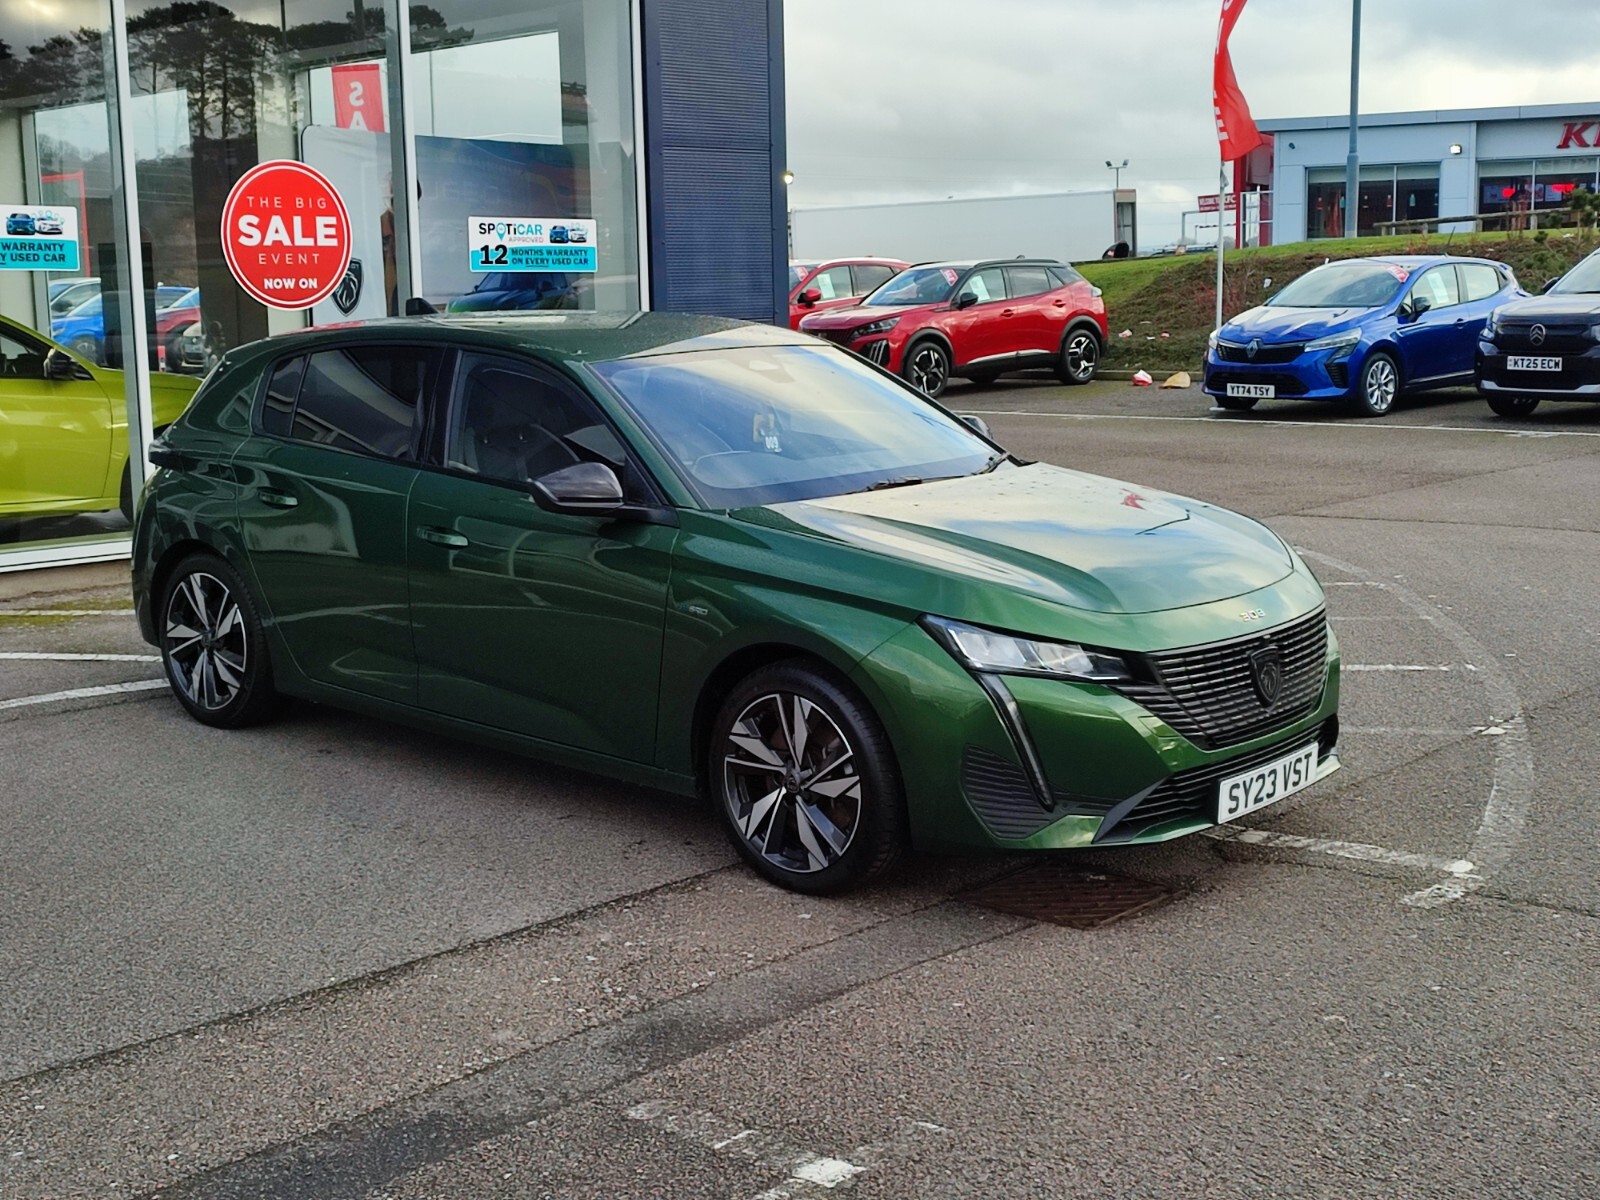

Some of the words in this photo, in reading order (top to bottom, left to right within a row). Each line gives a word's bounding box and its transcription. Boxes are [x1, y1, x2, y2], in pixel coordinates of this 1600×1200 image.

[247, 196, 282, 208] THE
[295, 197, 327, 209] BIG
[237, 214, 338, 247] SALE
[1, 242, 65, 252] WARRANTY
[10, 253, 40, 262] USED
[43, 253, 66, 262] CAR
[480, 244, 509, 265] 12
[546, 249, 588, 257] WARRANTY
[258, 253, 320, 265] EVENT
[511, 257, 523, 265] ON
[525, 257, 549, 265] EVERY
[263, 278, 296, 289] NOW
[299, 278, 318, 289] ON
[1513, 358, 1539, 368] KT25
[1230, 385, 1251, 395] YT74
[1253, 386, 1270, 396] TSY
[1228, 768, 1278, 815] SY23
[1283, 751, 1313, 793] VST
